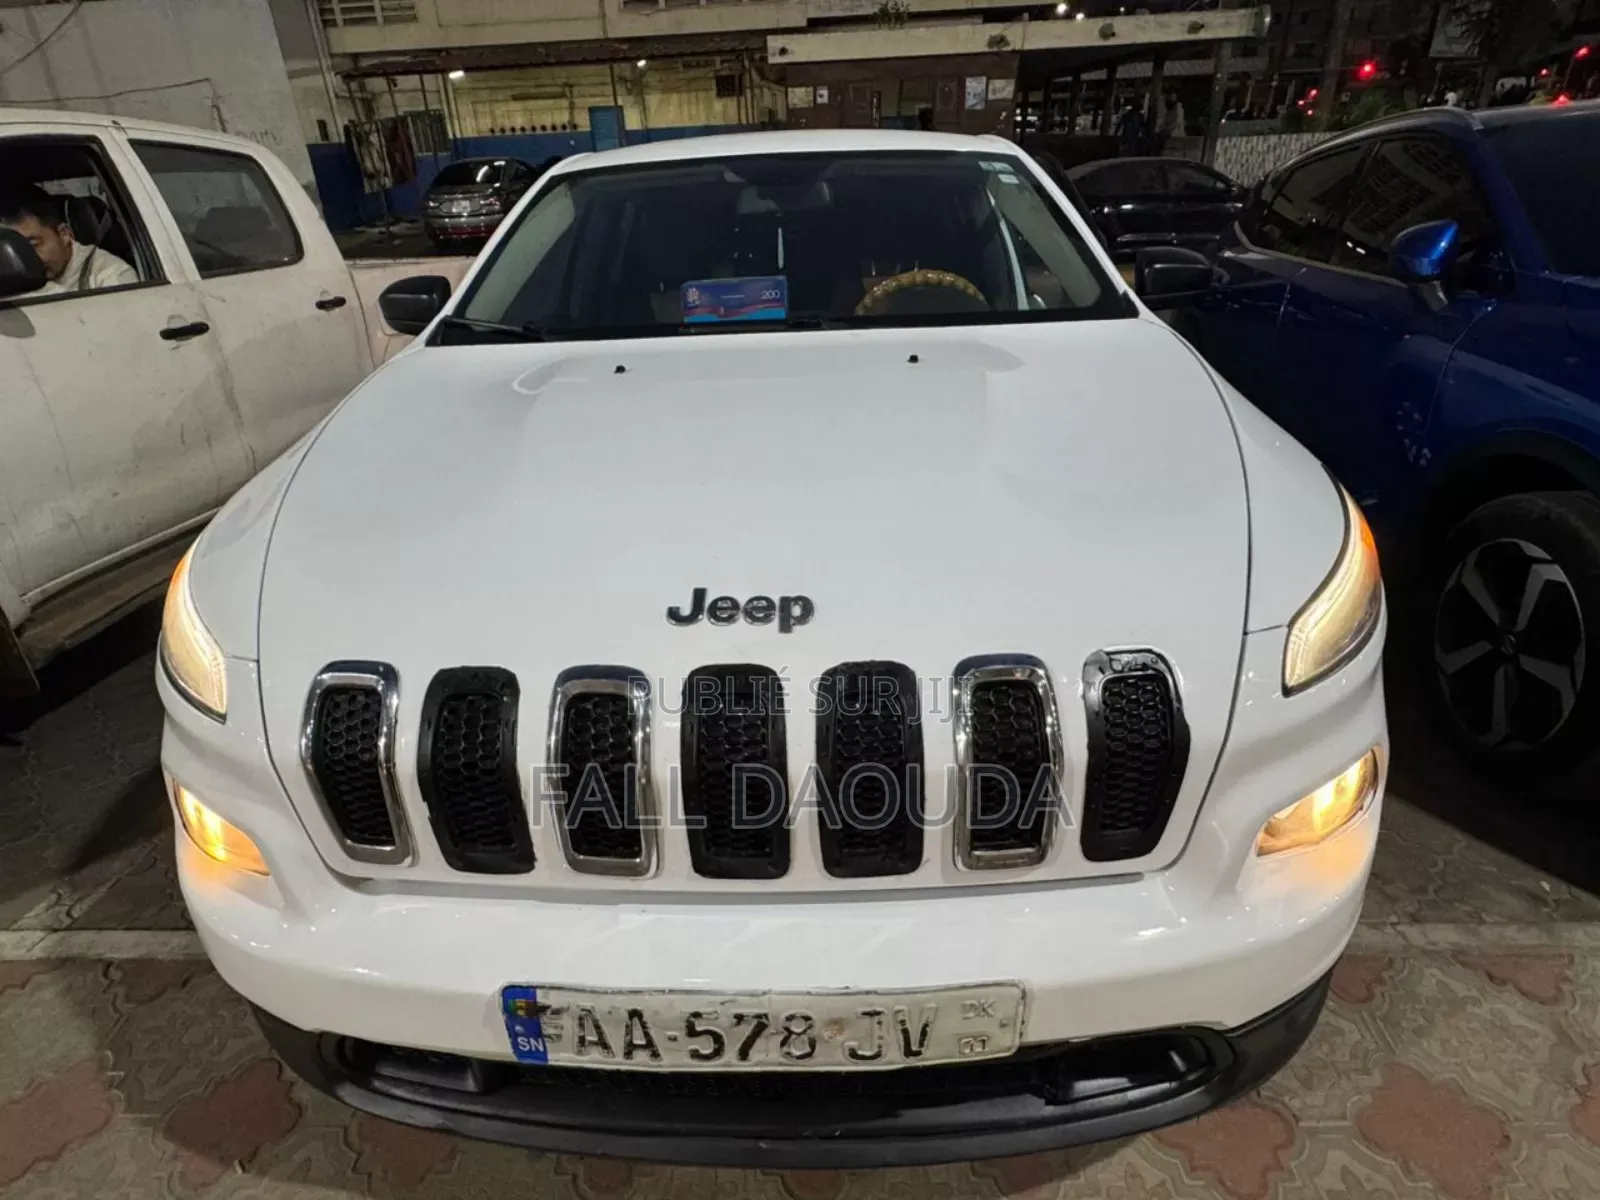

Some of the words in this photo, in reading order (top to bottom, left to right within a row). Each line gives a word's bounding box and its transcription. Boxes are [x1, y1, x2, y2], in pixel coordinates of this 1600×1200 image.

[760, 289, 780, 300] 200
[667, 587, 815, 634] Jeep
[961, 1000, 996, 1019] DK
[516, 1036, 545, 1052] SN
